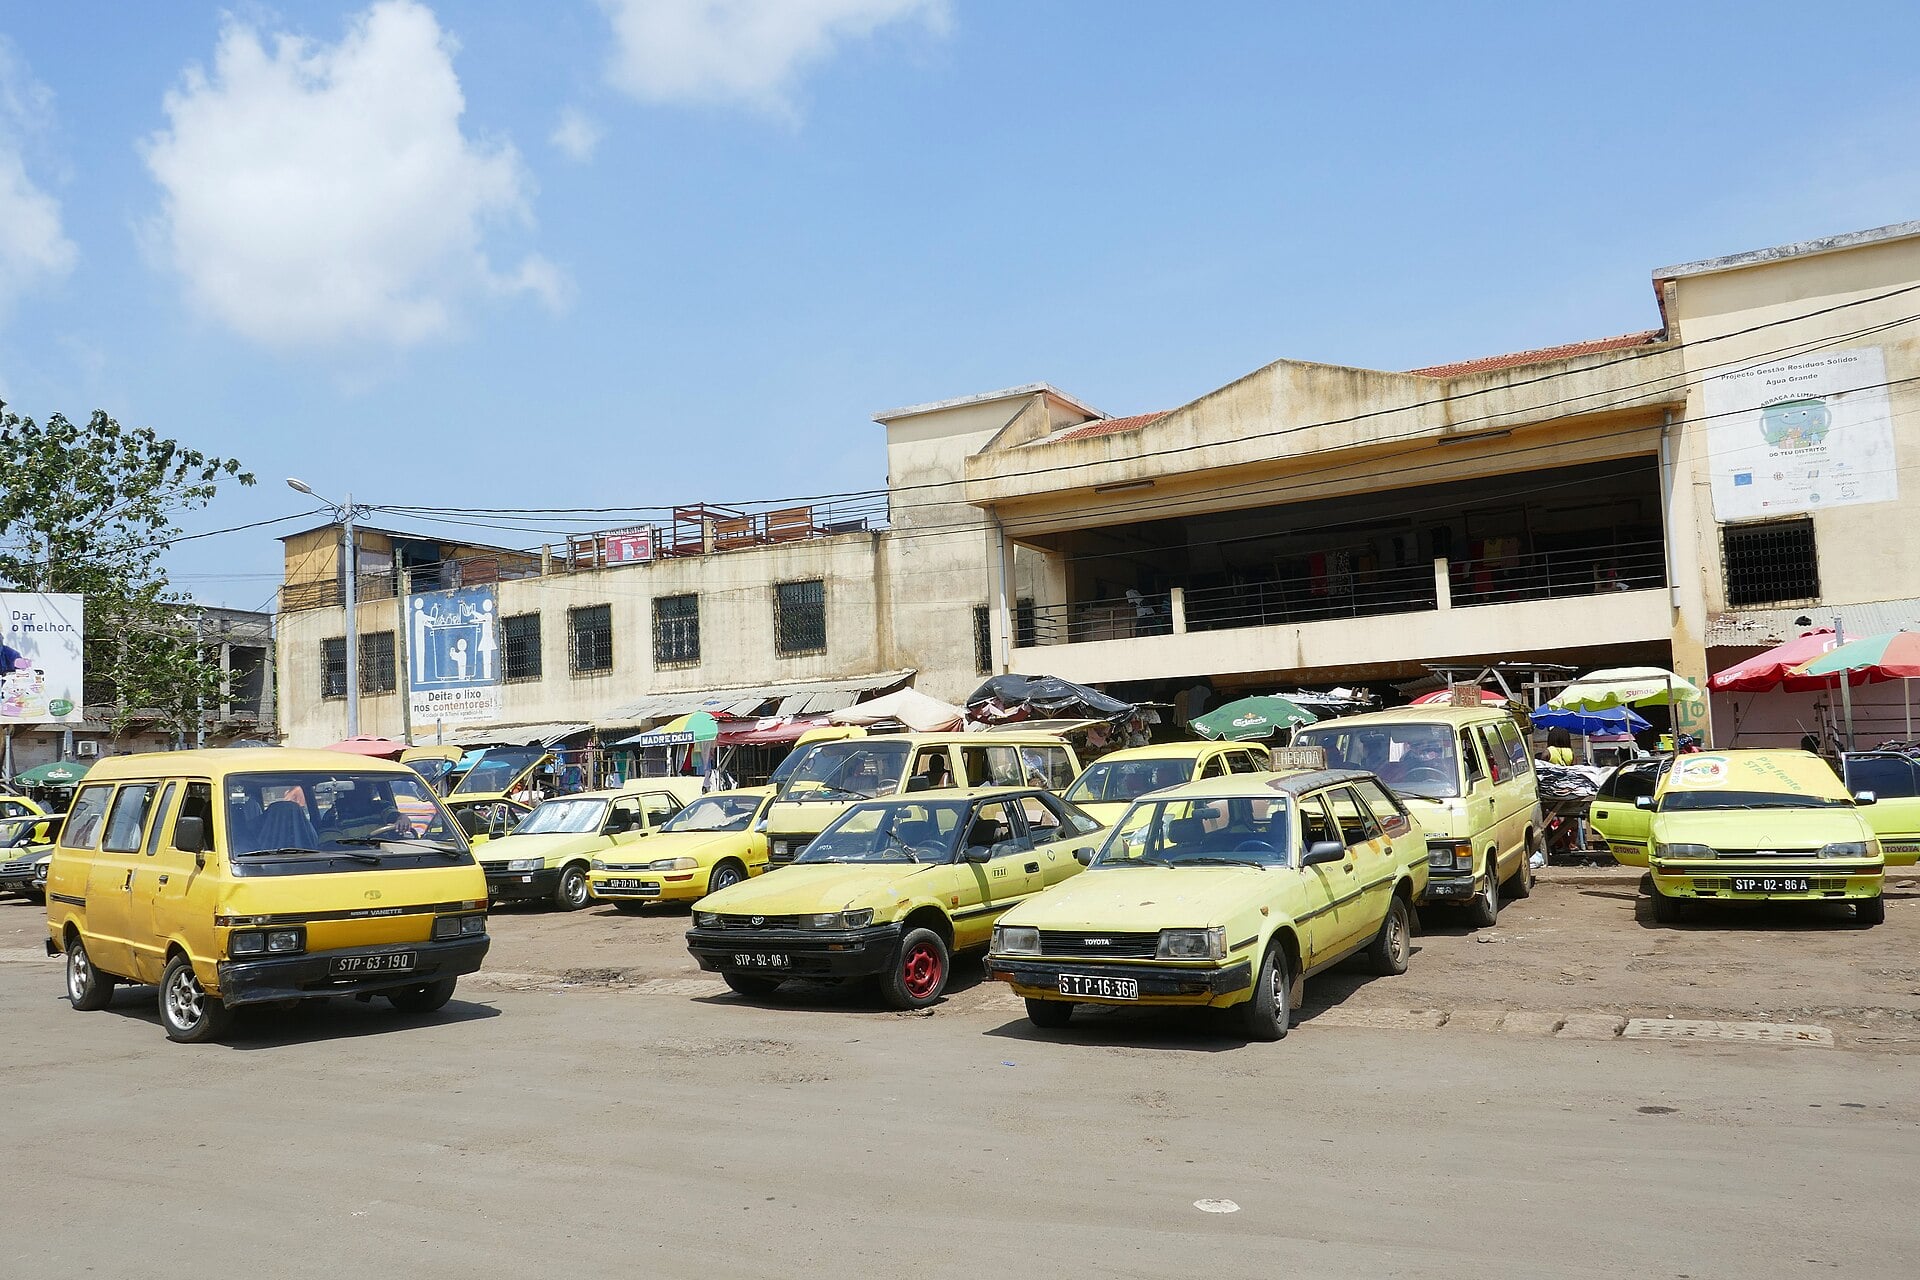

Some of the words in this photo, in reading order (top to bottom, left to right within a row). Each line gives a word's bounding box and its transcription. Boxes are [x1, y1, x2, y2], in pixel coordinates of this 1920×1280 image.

[1720, 371, 1755, 381] Projecto
[1788, 373, 1818, 383] Grande
[12, 610, 36, 621] Dar
[11, 624, 19, 632] o
[23, 622, 75, 632] melhor.
[428, 691, 453, 702] Deita
[455, 692, 462, 700] o
[464, 689, 482, 700] lixo
[414, 704, 431, 712] nos
[432, 698, 493, 712] contentores!
[642, 735, 671, 745] MADRE
[671, 733, 693, 743] DEUS
[1274, 750, 1321, 766] CHEGADA
[1884, 845, 1919, 853] TOYOTA
